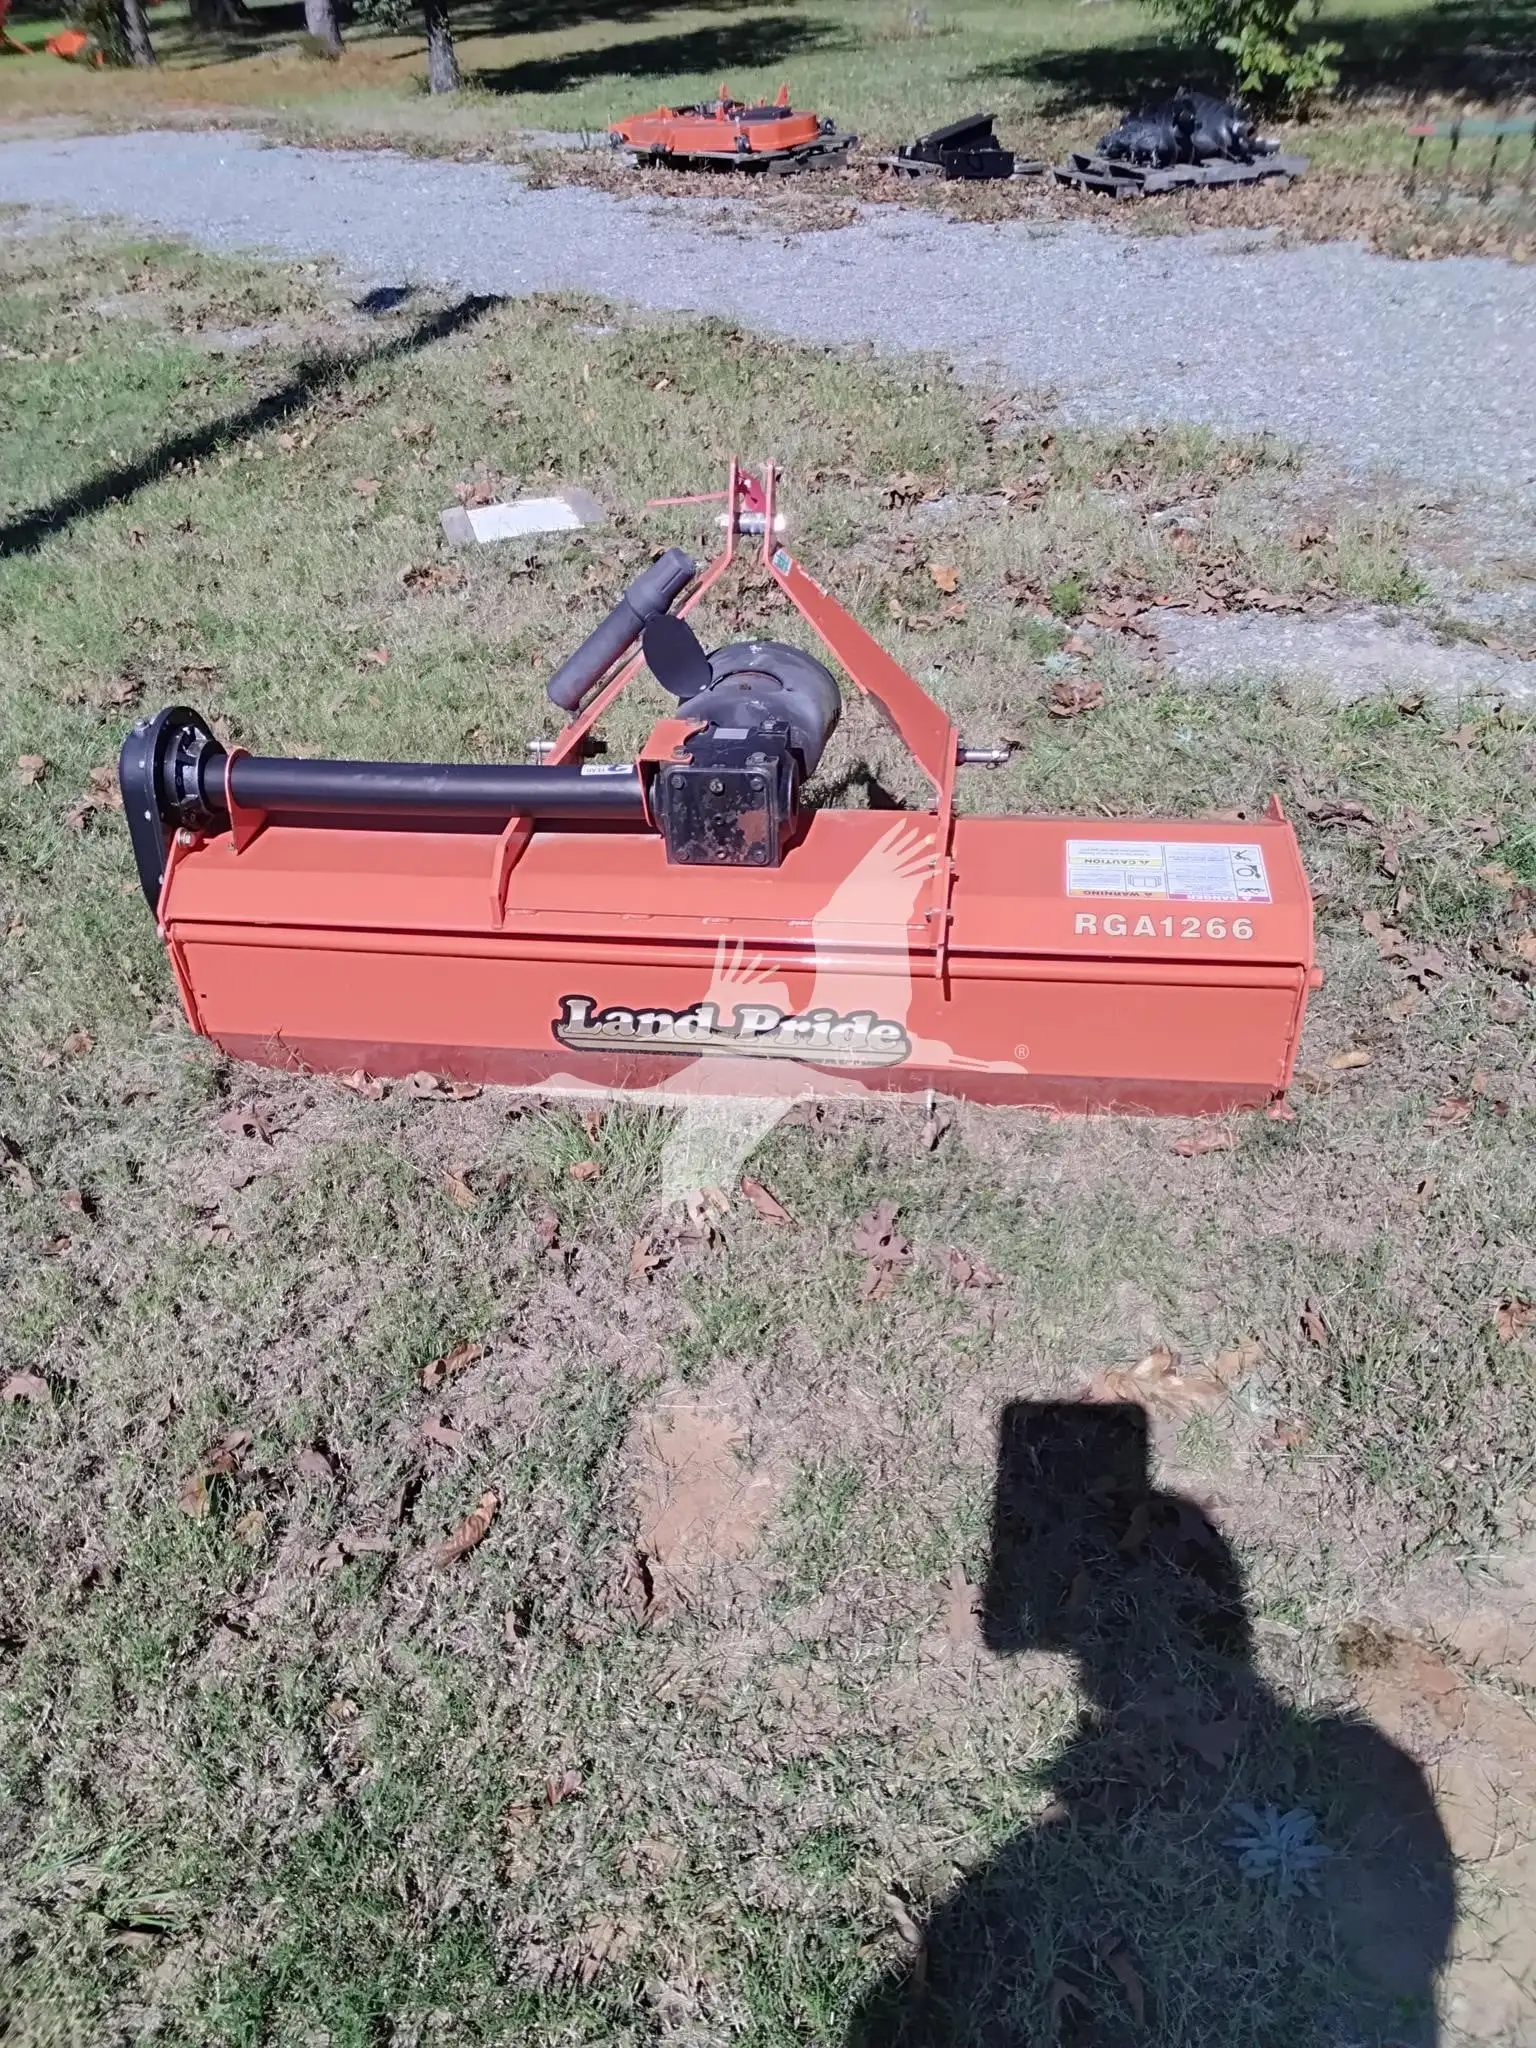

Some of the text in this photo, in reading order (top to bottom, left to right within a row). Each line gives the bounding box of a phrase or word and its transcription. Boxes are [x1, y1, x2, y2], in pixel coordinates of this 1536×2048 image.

[1073, 912, 1254, 940] RGA1266
[561, 998, 902, 1051] Land Pride
